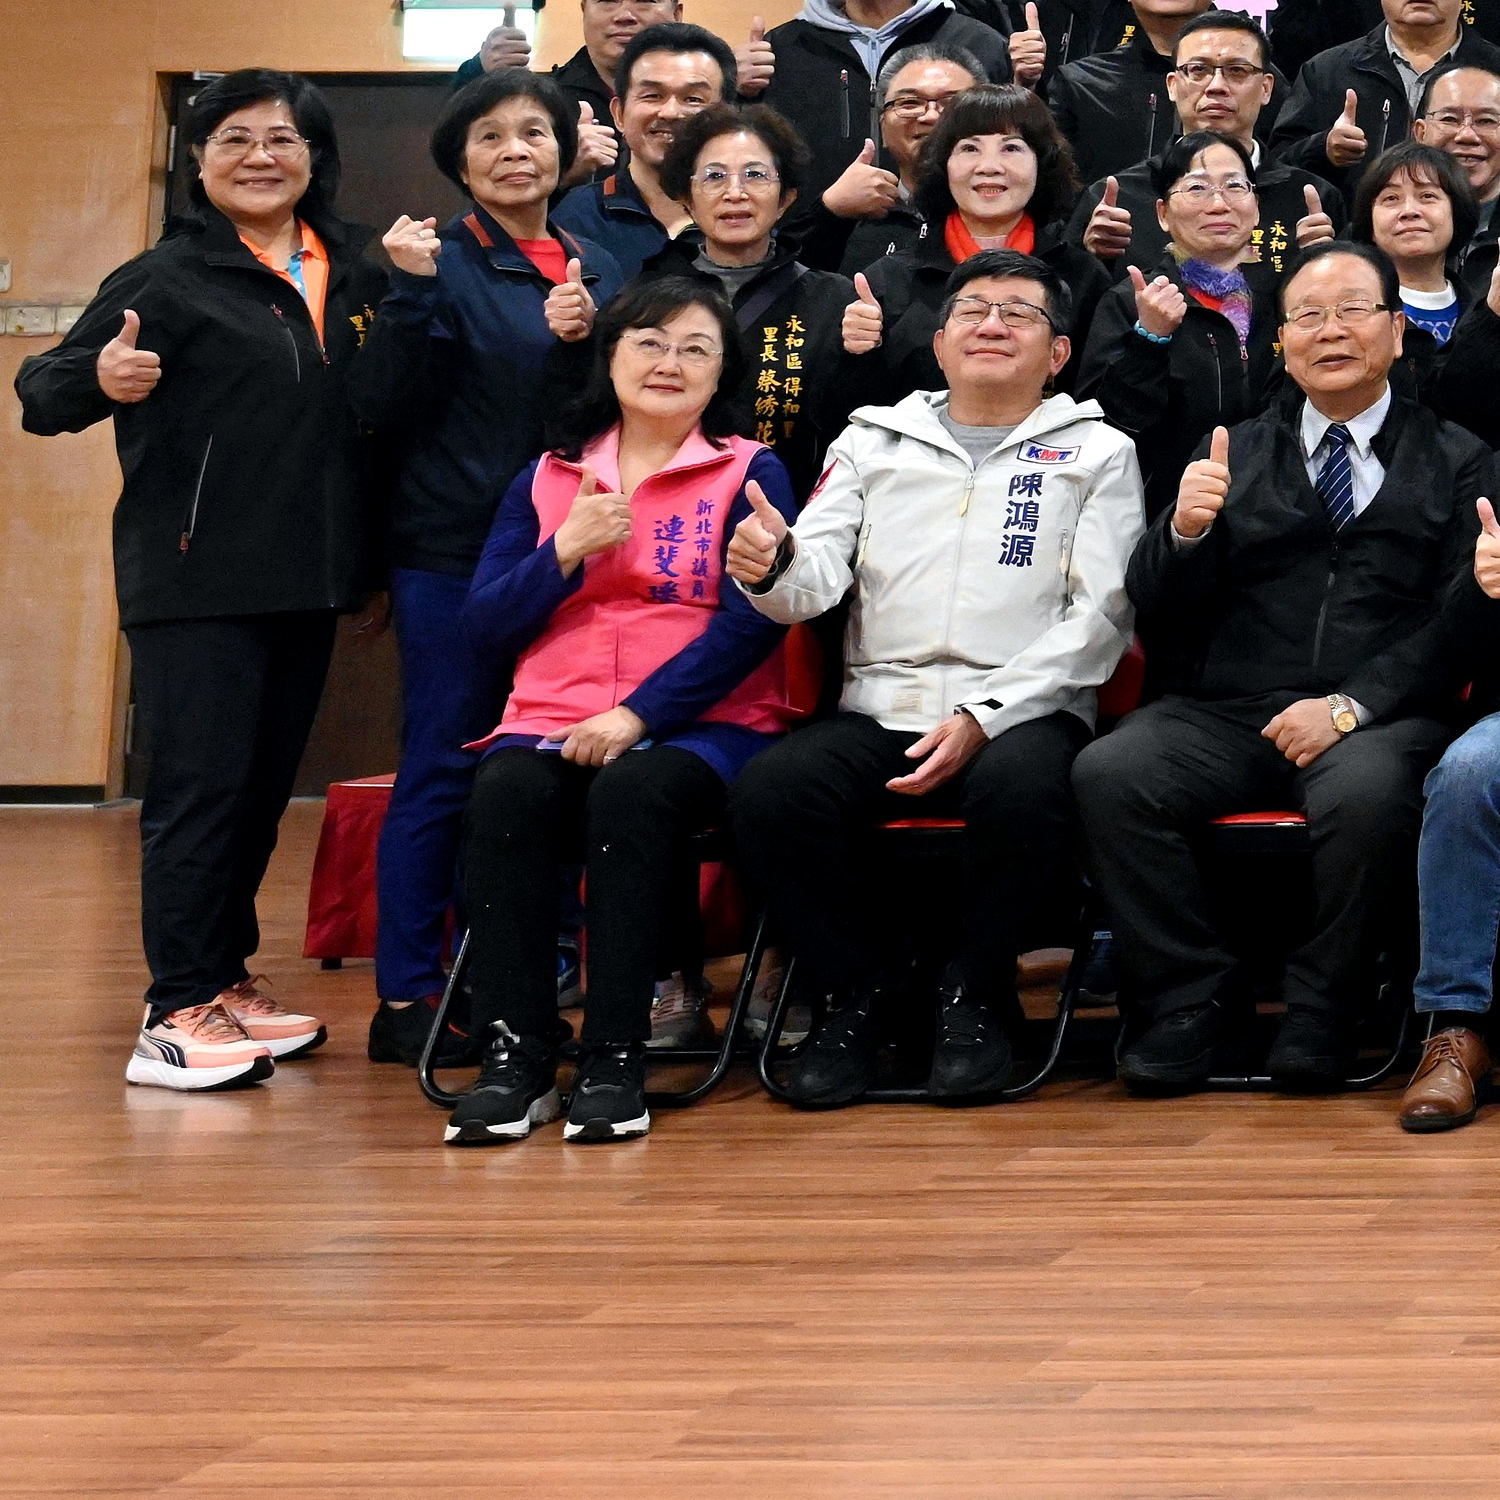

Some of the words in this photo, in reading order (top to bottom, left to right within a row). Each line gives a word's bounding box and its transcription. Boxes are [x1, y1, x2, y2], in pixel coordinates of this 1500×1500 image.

[759, 326, 780, 363] 里長
[784, 314, 807, 370] 永和區
[754, 368, 782, 446] 蔡綉花
[781, 376, 804, 440] 得和里
[1025, 445, 1074, 462] KMT
[690, 498, 715, 600] 新北市議員
[997, 471, 1047, 568] 陳鴻源
